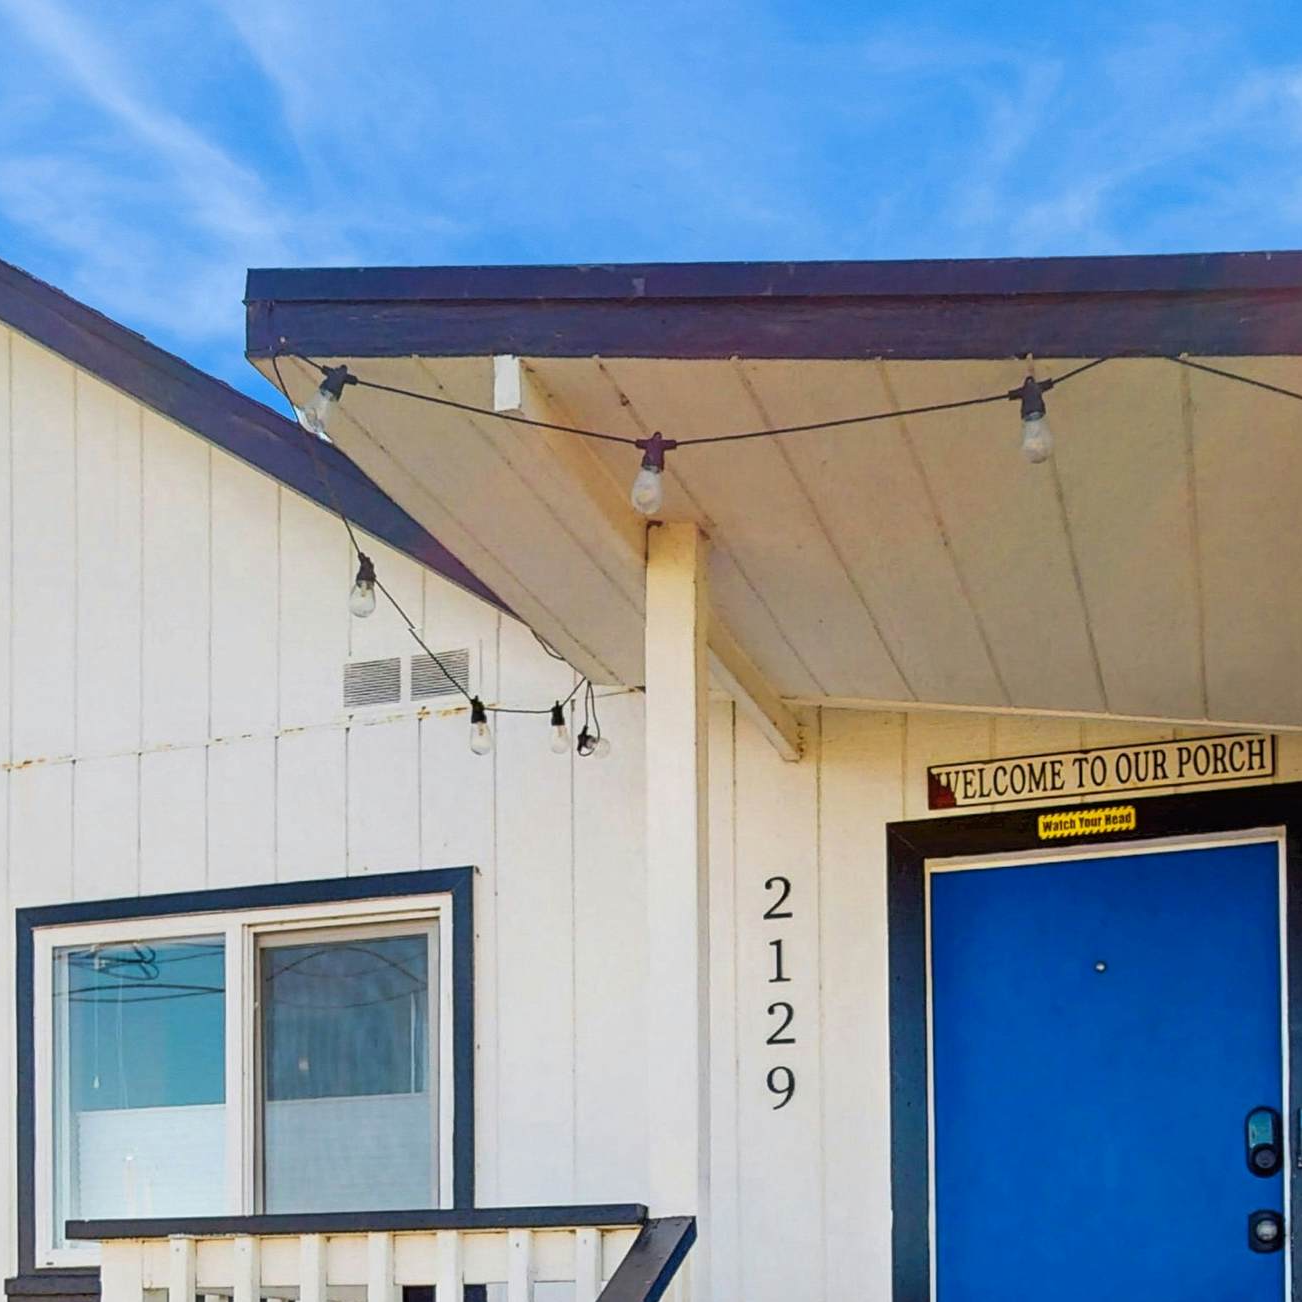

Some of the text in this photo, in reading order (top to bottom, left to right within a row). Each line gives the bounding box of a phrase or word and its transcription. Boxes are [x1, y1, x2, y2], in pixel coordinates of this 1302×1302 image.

[936, 739, 1266, 799] WELCOME TO OUR PORCH
[1043, 812, 1132, 832] Watch Your Head
[763, 876, 796, 1110] 2129
